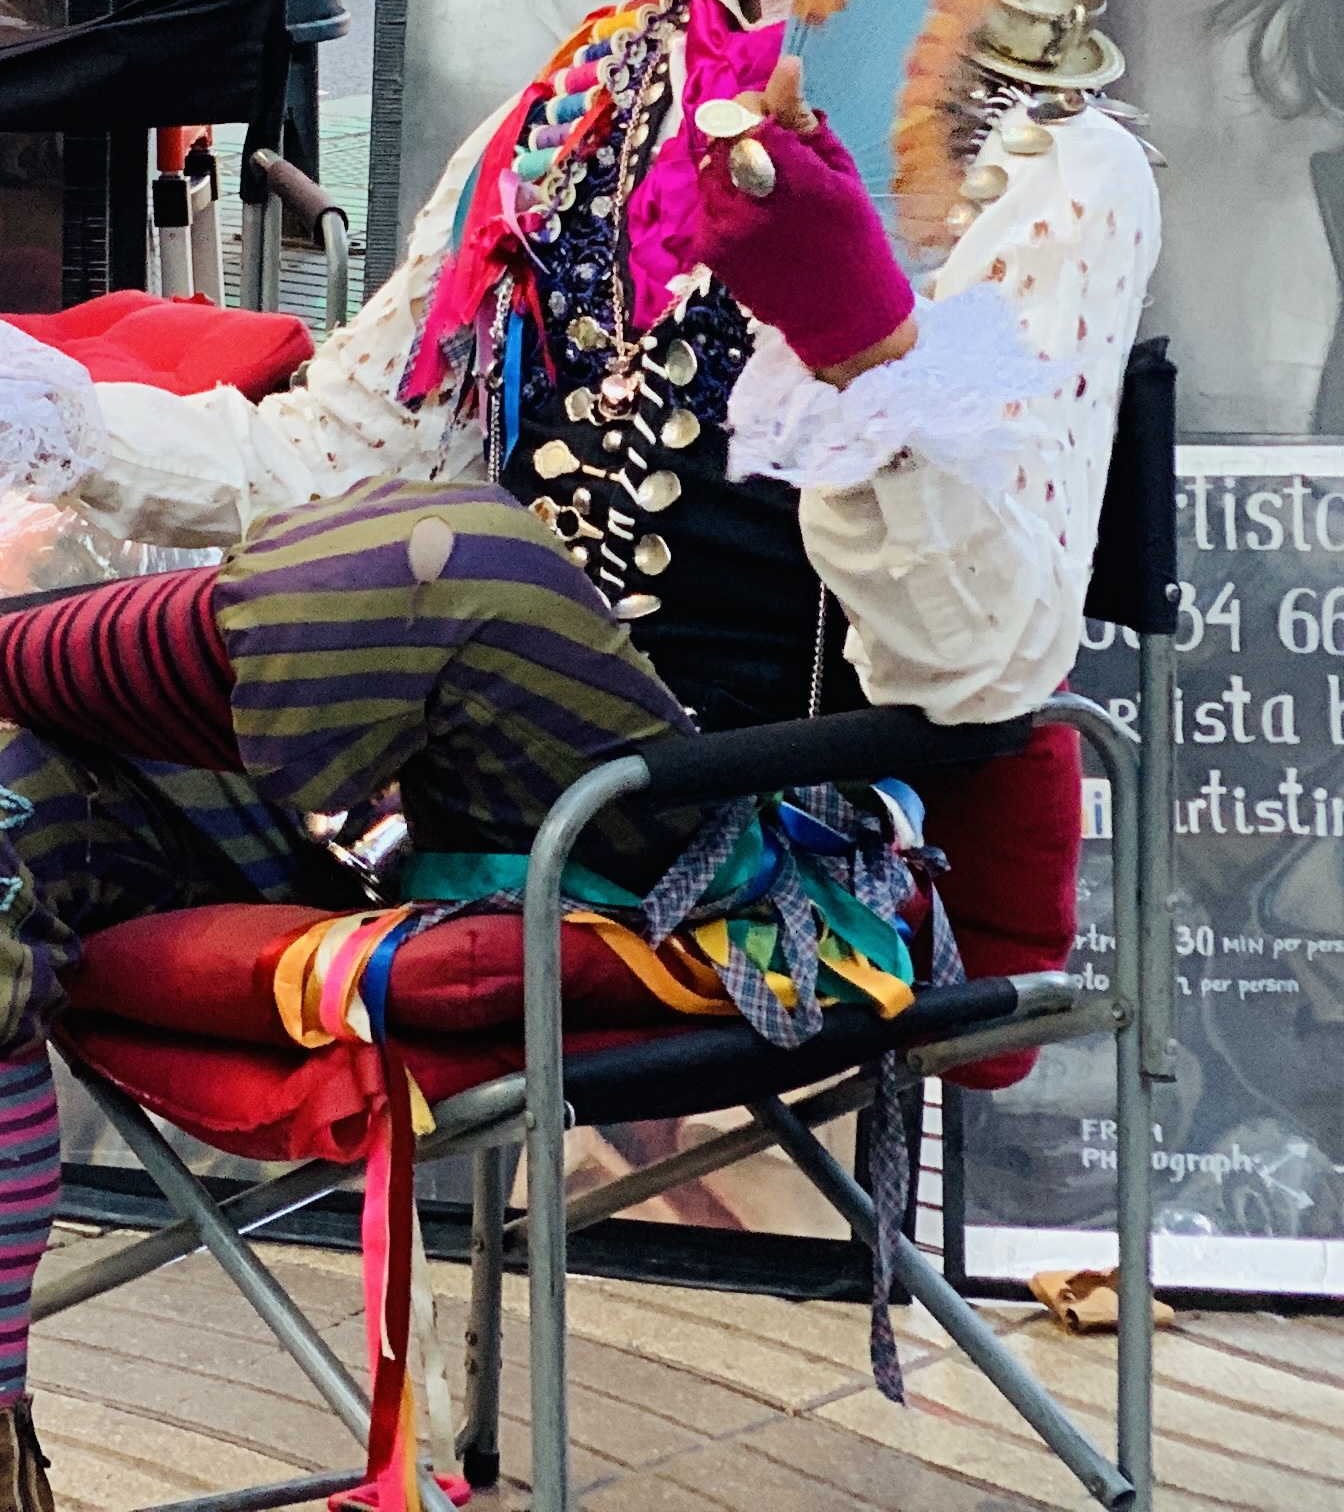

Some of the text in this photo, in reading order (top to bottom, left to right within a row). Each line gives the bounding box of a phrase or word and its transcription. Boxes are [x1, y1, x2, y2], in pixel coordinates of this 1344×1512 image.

[1175, 925, 1214, 956] 30
[1223, 935, 1263, 955] MIN
[1082, 1143, 1253, 1184] PHograph
